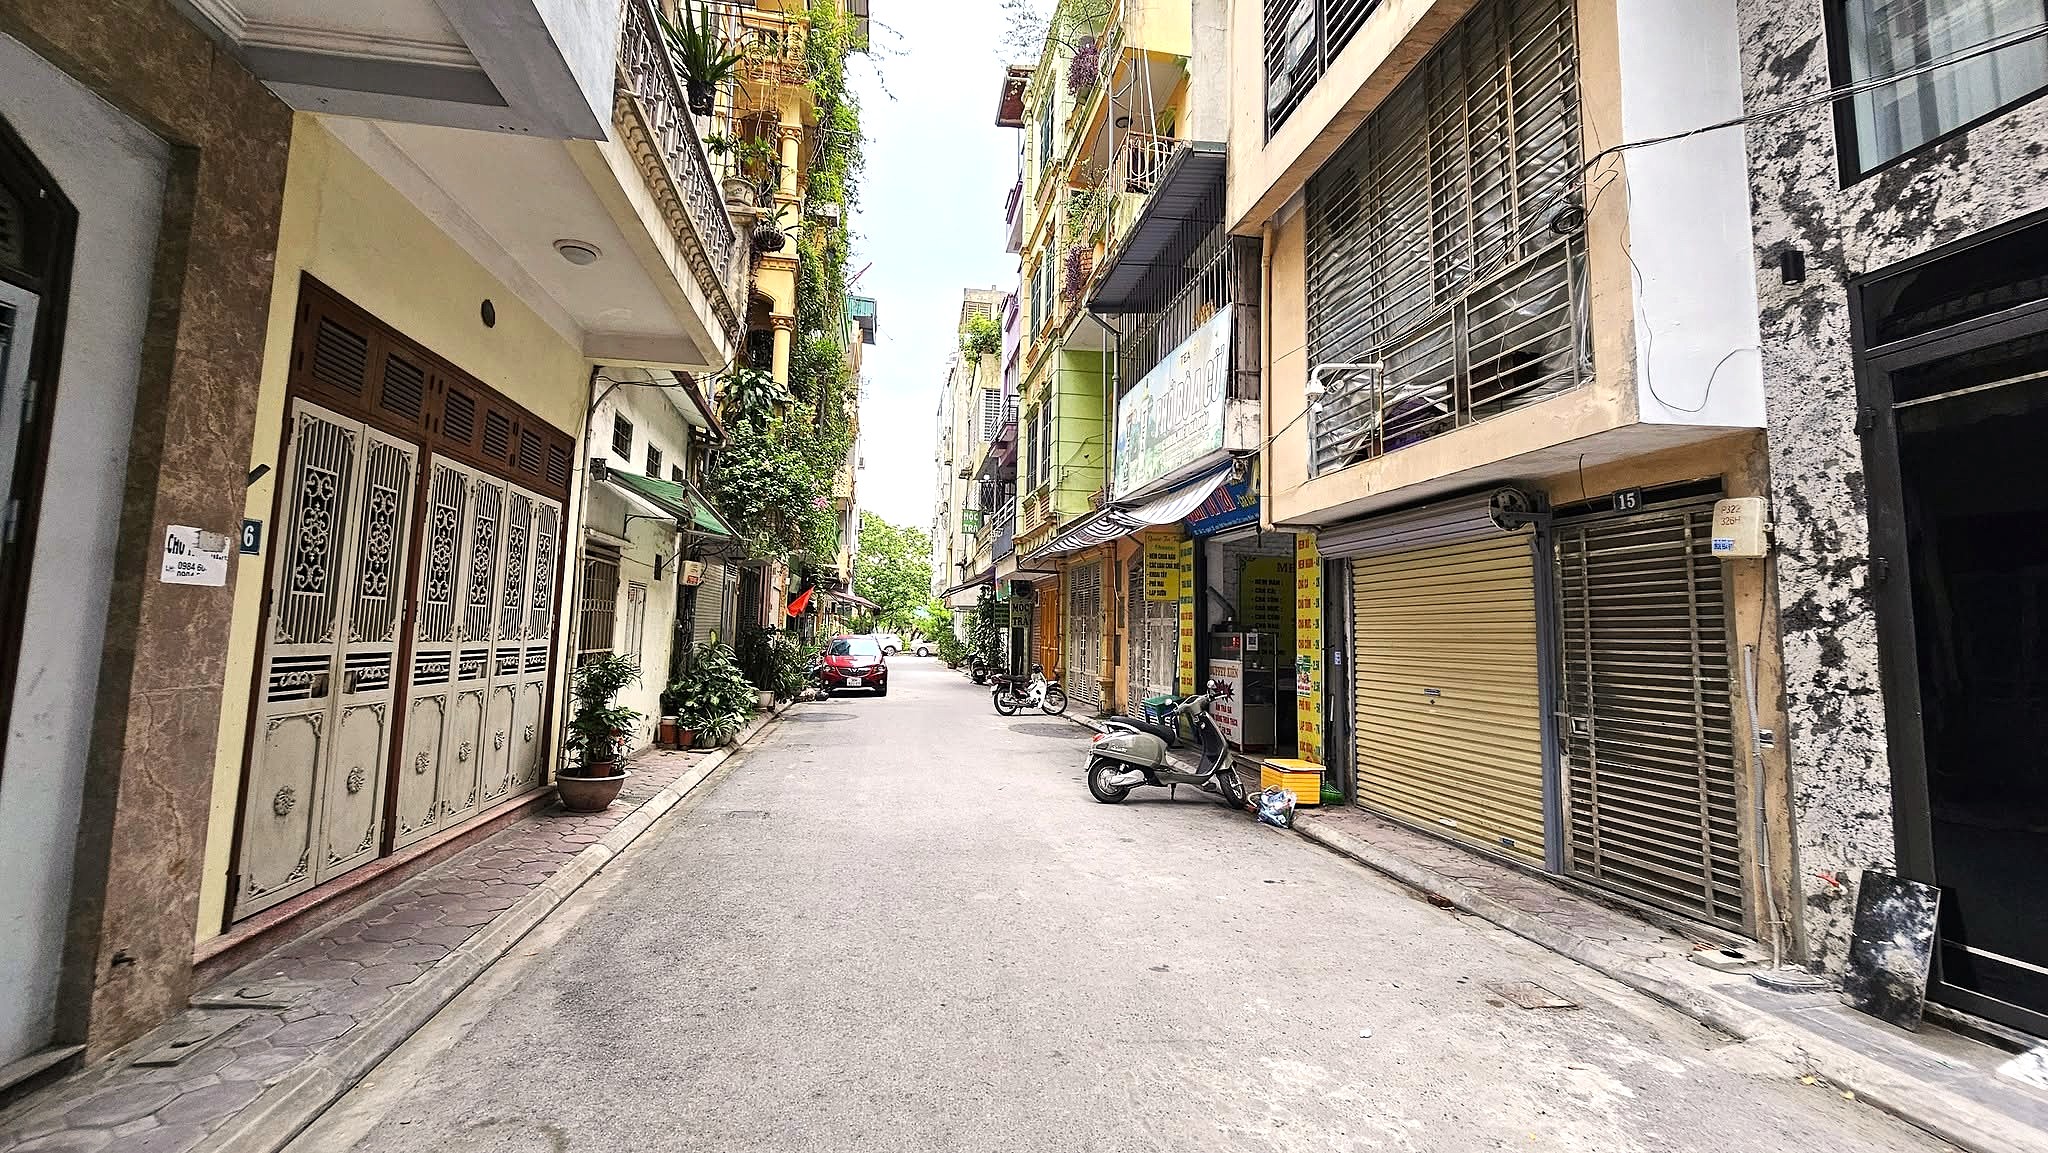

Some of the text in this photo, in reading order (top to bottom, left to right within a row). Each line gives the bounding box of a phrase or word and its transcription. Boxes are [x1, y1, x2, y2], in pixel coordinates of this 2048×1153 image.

[1619, 492, 1636, 510] 15
[243, 525, 254, 547] 6
[178, 561, 196, 571] 0984
